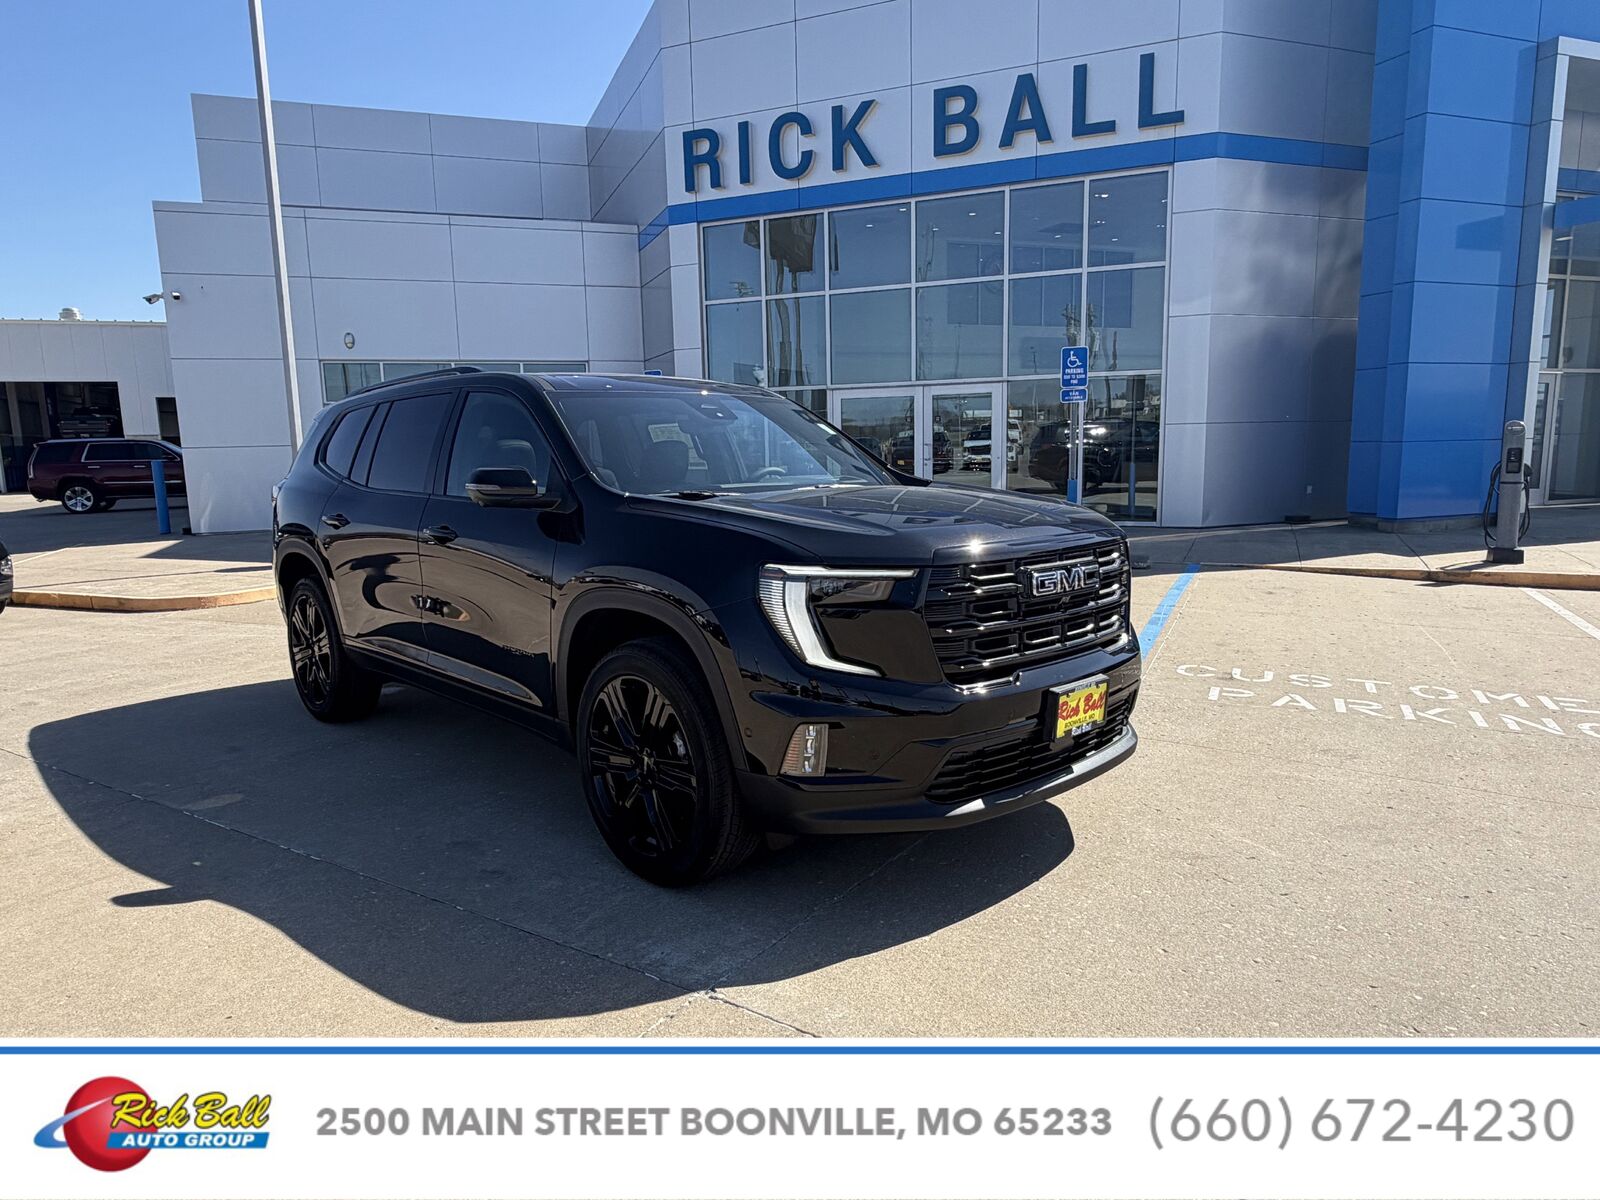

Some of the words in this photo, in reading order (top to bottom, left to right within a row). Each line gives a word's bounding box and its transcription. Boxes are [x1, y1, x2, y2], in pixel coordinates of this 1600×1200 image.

[682, 98, 879, 194] RICK
[933, 52, 1185, 159] BALL
[1032, 564, 1099, 597] GMC
[1058, 697, 1081, 721] Rick
[1083, 691, 1105, 715] Ball
